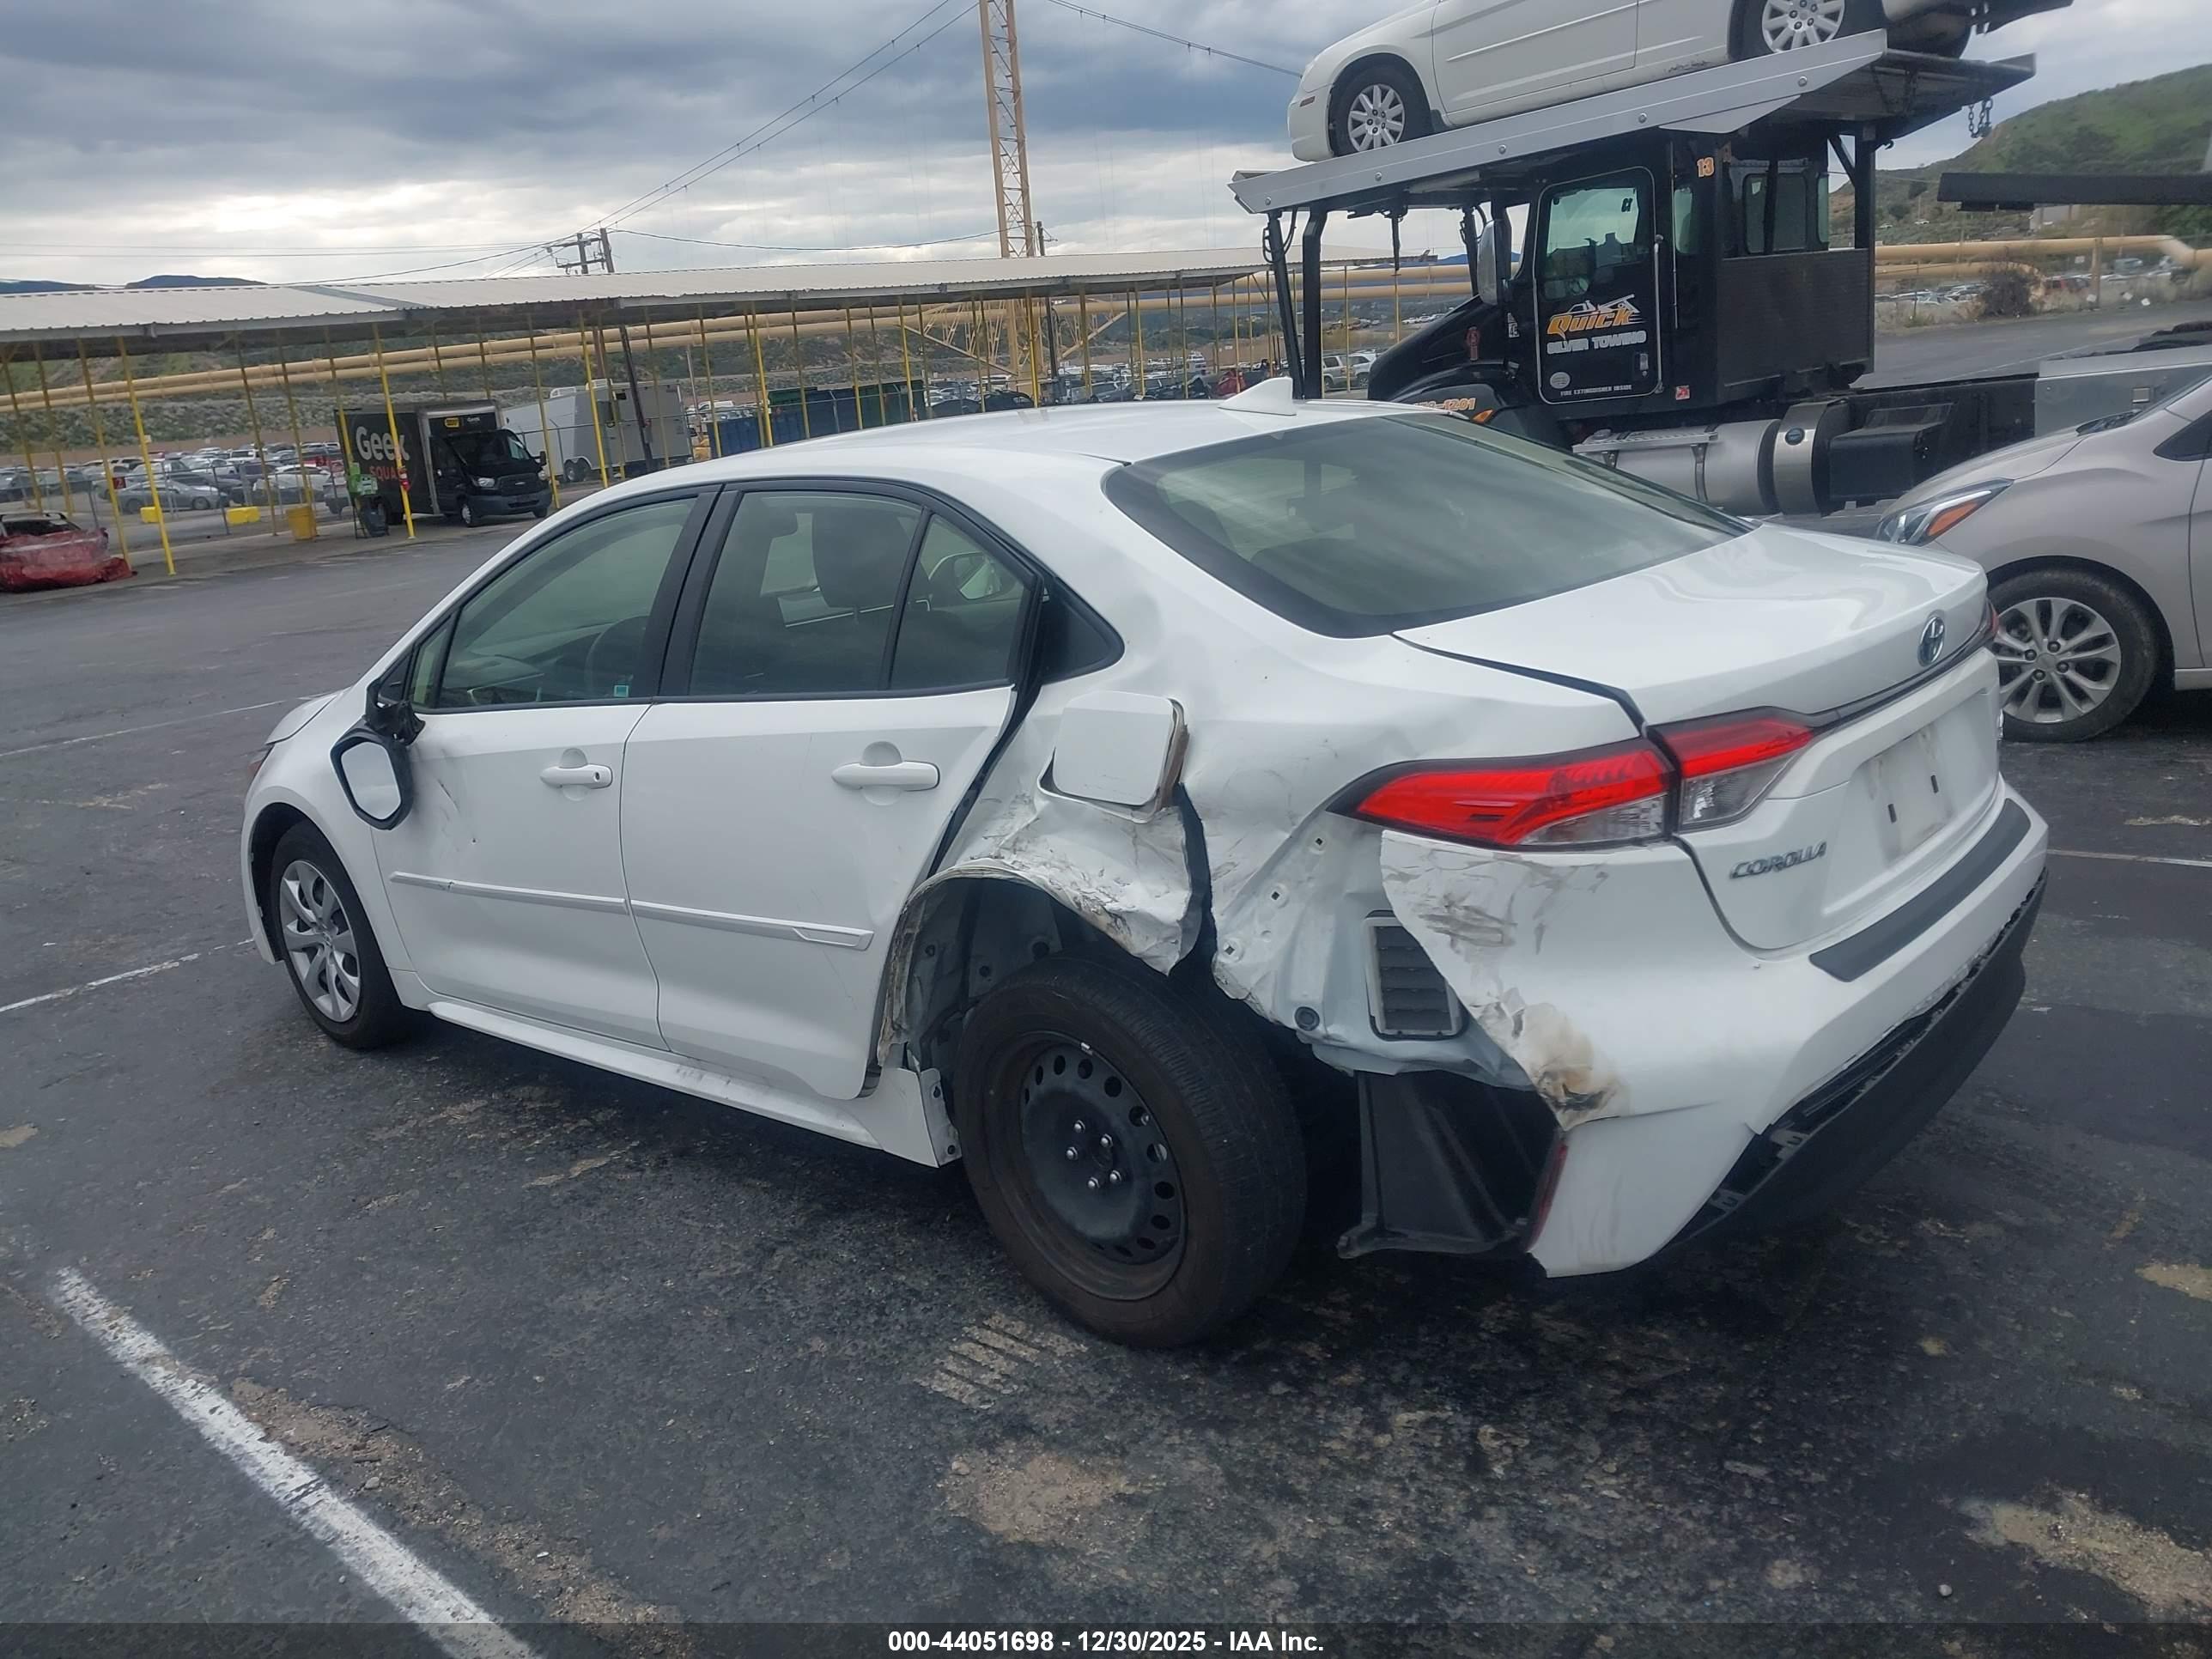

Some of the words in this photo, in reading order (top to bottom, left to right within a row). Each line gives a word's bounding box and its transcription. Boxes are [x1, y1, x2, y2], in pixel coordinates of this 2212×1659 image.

[1697, 156, 1715, 178] 13
[1591, 330, 1647, 349] TOWING
[369, 465, 400, 482] SQUA
[1729, 840, 1826, 879] COROLLA
